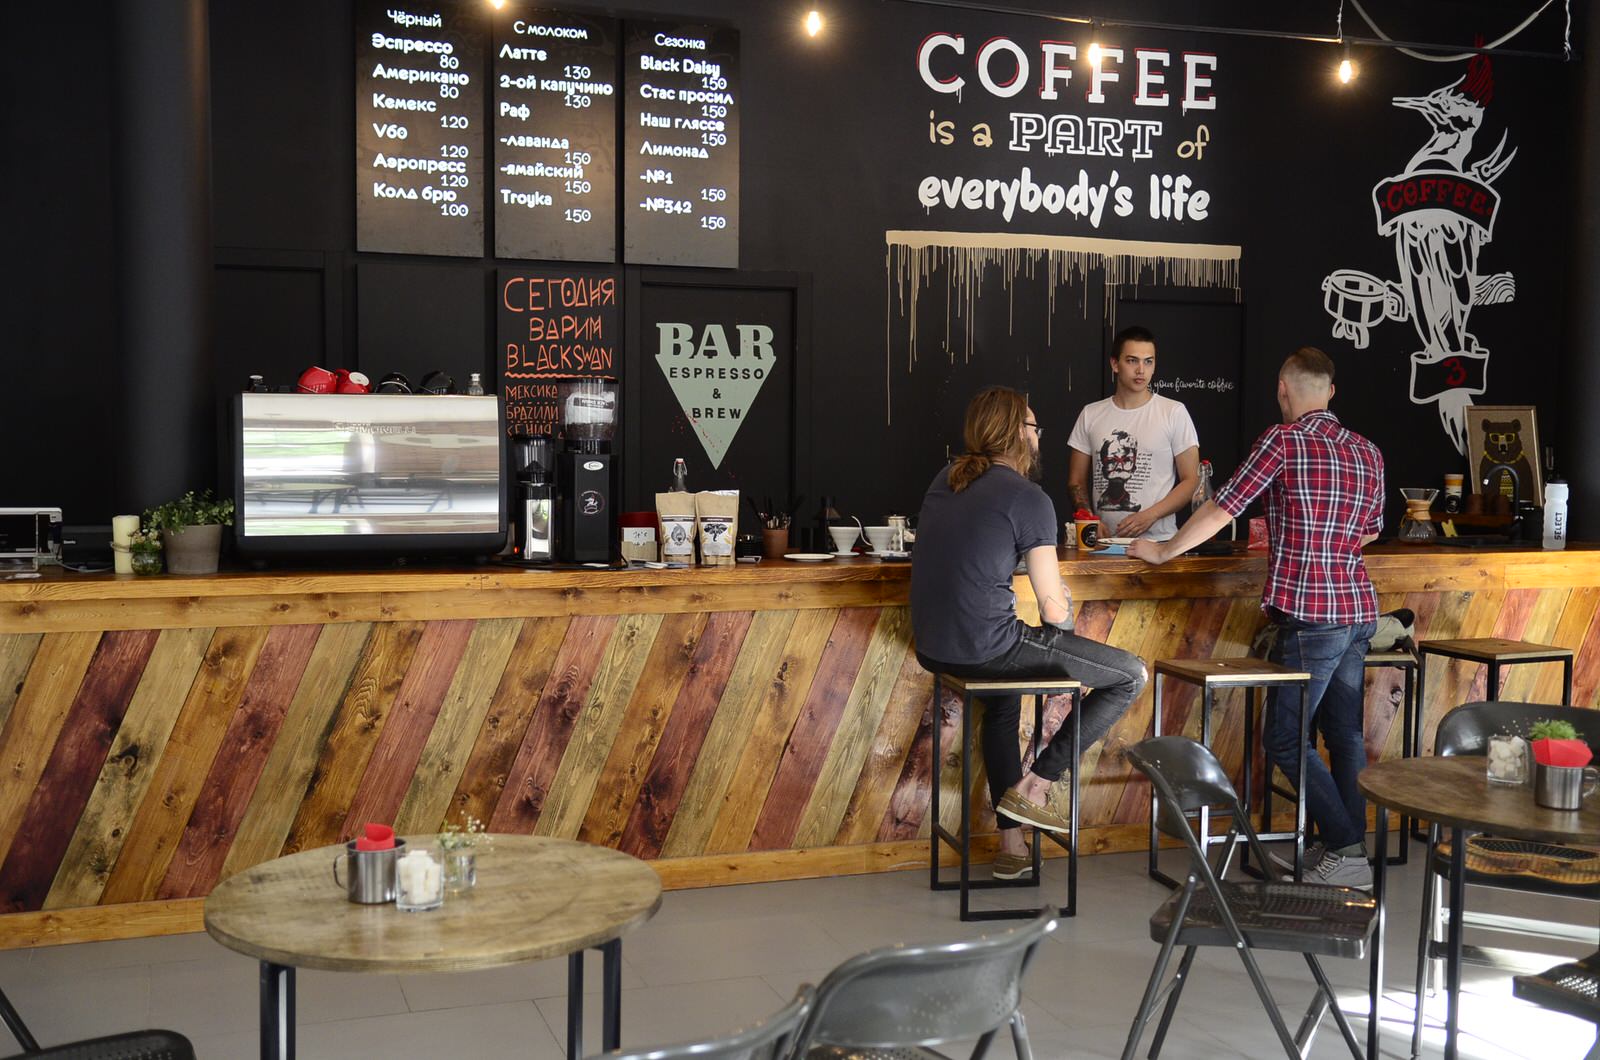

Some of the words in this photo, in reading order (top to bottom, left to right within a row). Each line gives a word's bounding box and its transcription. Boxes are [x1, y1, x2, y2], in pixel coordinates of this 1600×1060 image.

[387, 9, 442, 28] Чёрный
[513, 20, 526, 34] С
[527, 25, 588, 40] молоком
[371, 33, 454, 54] Эспрессо
[654, 33, 706, 50] Сезонка
[440, 54, 459, 69] 80
[499, 43, 548, 62] Латте
[372, 63, 470, 85] Американо
[564, 65, 591, 80] 130
[640, 55, 680, 72] Black
[683, 58, 721, 80] Daisy
[916, 32, 1217, 112] COFFEE
[440, 84, 459, 99] 80
[499, 74, 537, 90] 2-ой
[540, 79, 614, 96] капучино
[701, 76, 728, 91] 150
[372, 92, 437, 113] Кемекс
[564, 94, 591, 109] 130
[640, 83, 675, 100] Стас
[679, 89, 735, 105] просил
[500, 102, 531, 121] Раф
[701, 104, 728, 119] 150
[440, 115, 469, 129] 120
[640, 112, 671, 128] Наш
[674, 117, 726, 132] гляссе
[500, 135, 570, 150] -лаванда
[701, 132, 727, 147] 150
[929, 110, 956, 145] is
[972, 121, 993, 148] a
[1009, 112, 1163, 158] PART
[1176, 124, 1210, 161] of
[440, 144, 469, 159] 120
[564, 151, 592, 165] 150
[640, 140, 709, 159] Лимонад
[373, 152, 467, 174] Аэропресс
[500, 162, 584, 179] -ямайский
[440, 174, 469, 188] 120
[564, 180, 592, 194] 150
[373, 182, 419, 199] Колд
[421, 185, 457, 204] брю
[500, 188, 553, 208] Troyka
[700, 188, 727, 202] 150
[918, 166, 1134, 228] everybody's
[1150, 174, 1211, 221] life
[1386, 179, 1489, 216] COFFEE
[440, 203, 469, 217] 100
[564, 208, 592, 223] 150
[700, 216, 727, 230] 150
[503, 277, 616, 312] СЕГОДНЯ
[529, 315, 603, 341] ВАРИМ
[655, 322, 777, 360] BAR
[669, 366, 765, 380] ESPRESSO
[712, 388, 722, 399] &
[1153, 379, 1174, 394] your
[1175, 377, 1205, 393] favorite
[1207, 377, 1235, 393] coffee
[692, 407, 742, 419] BREW
[1553, 511, 1563, 541] SELECT
